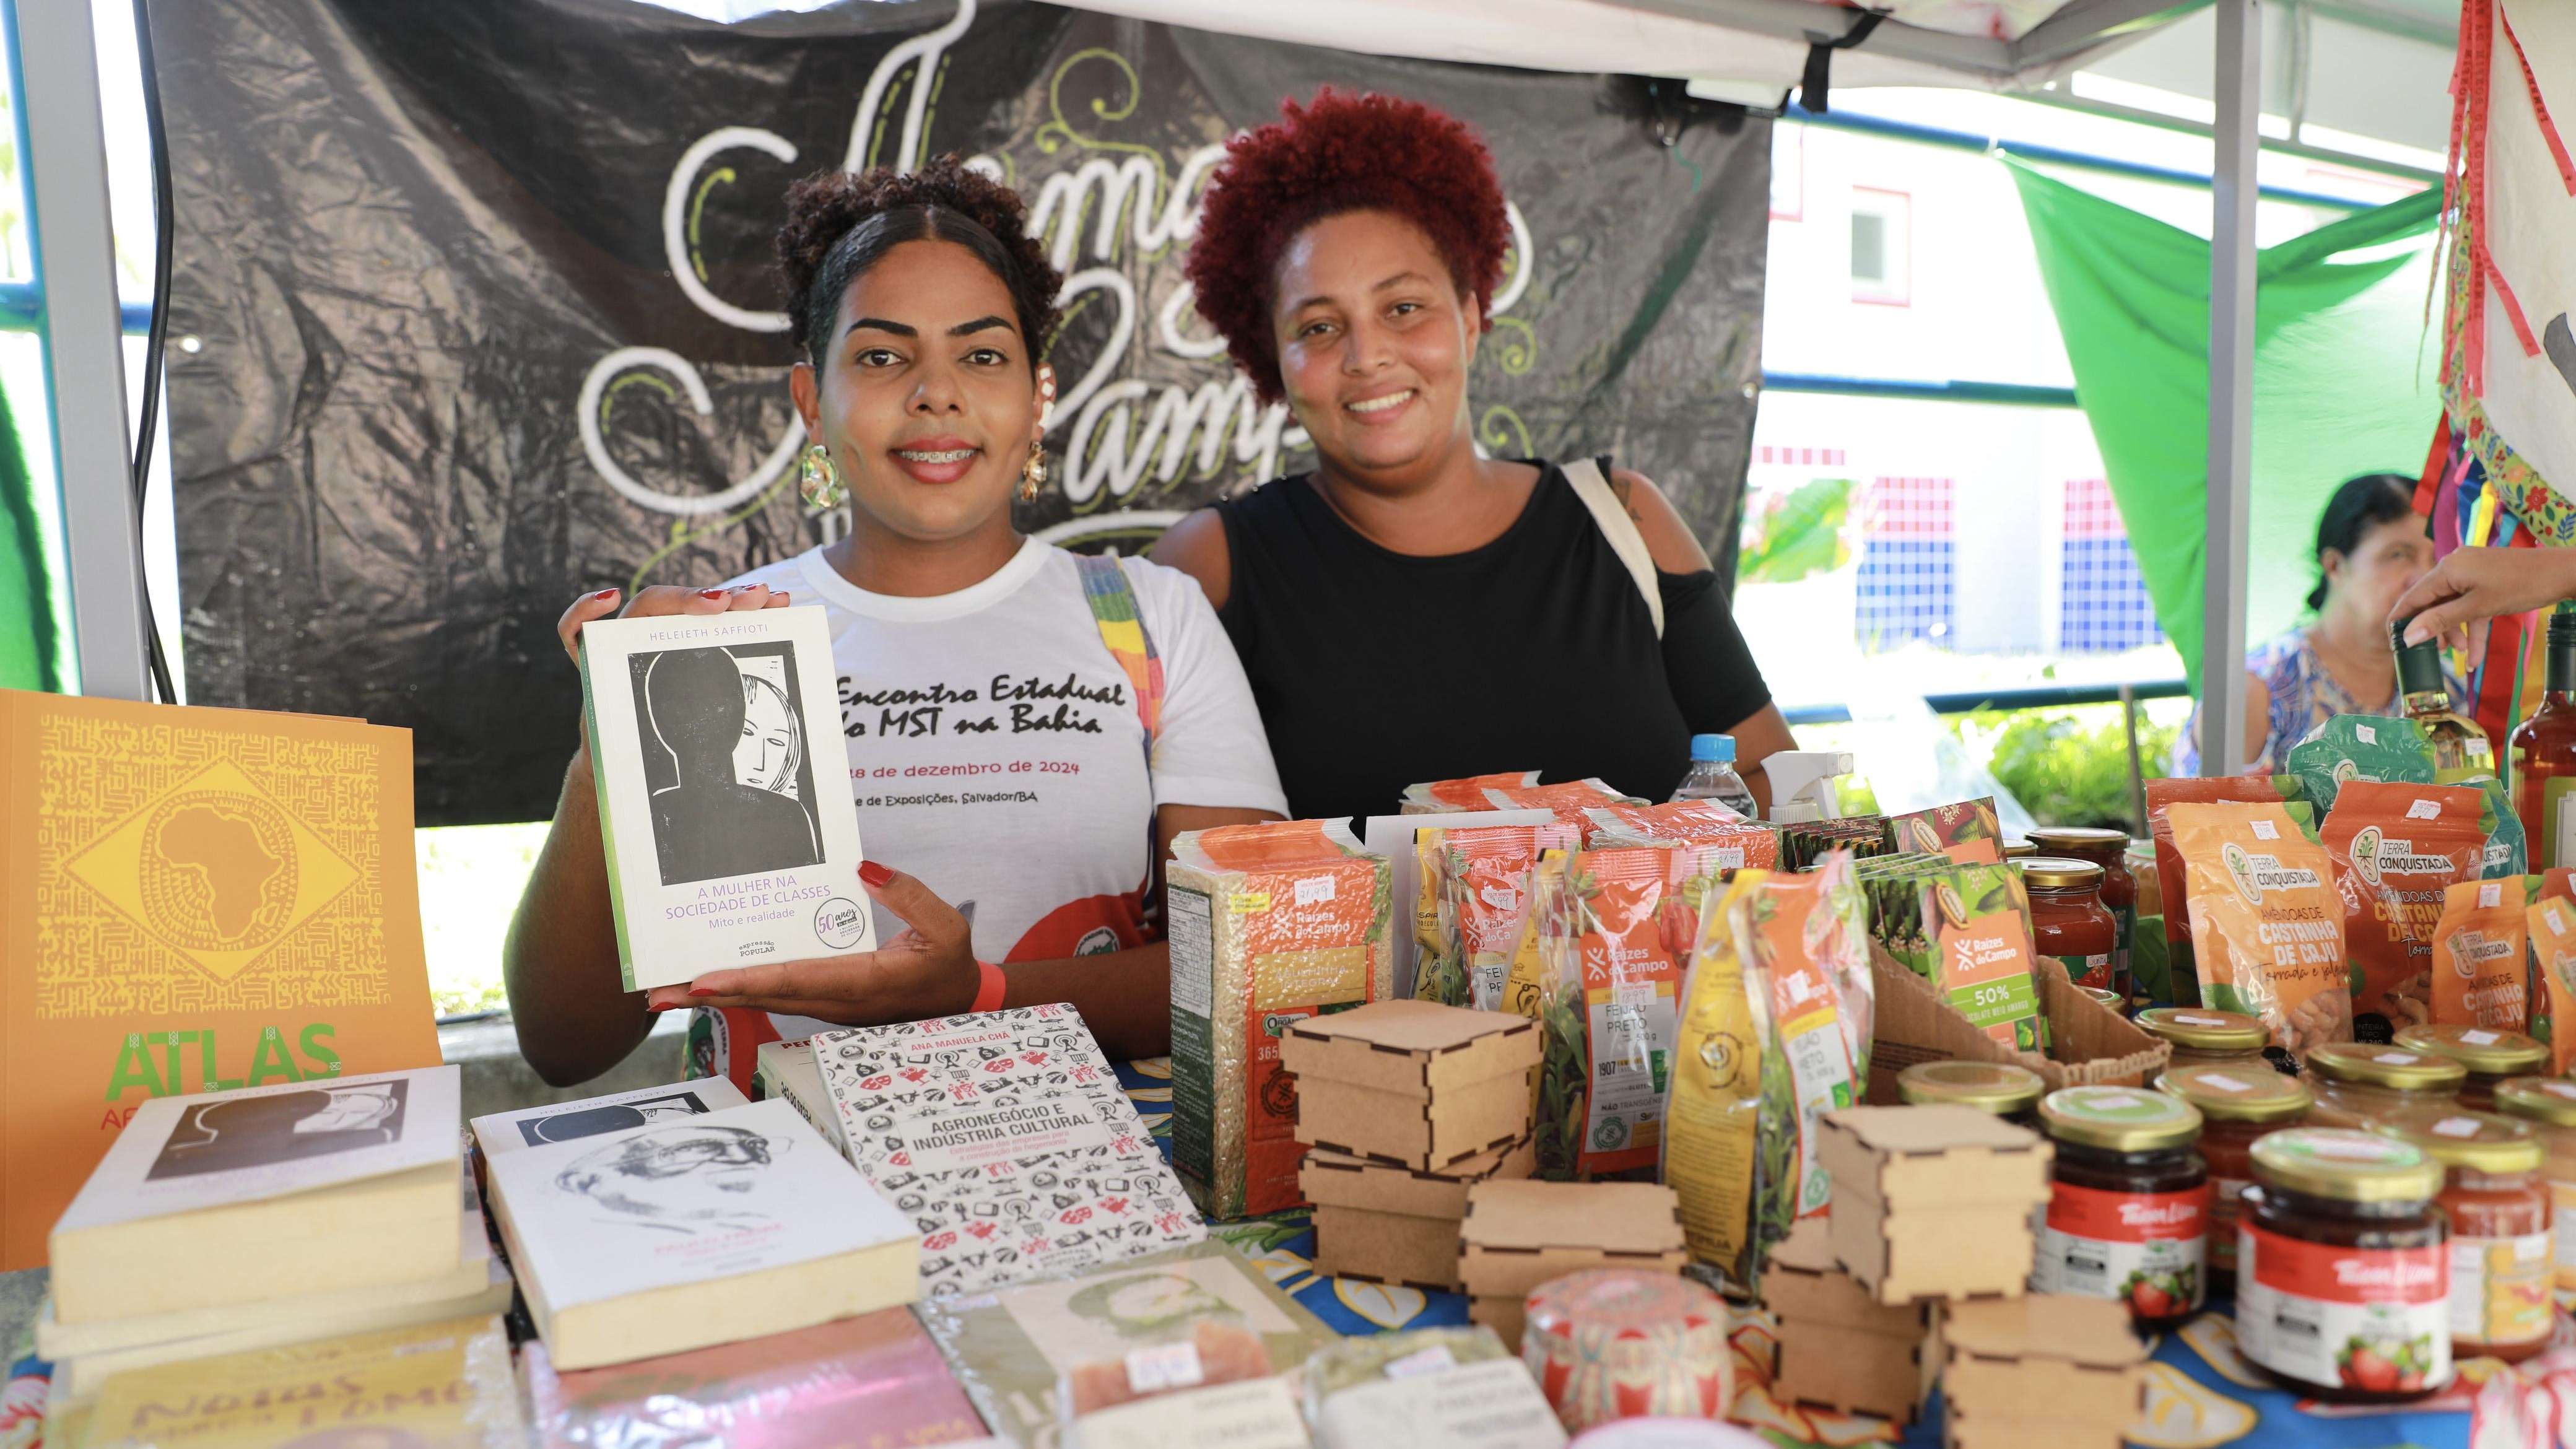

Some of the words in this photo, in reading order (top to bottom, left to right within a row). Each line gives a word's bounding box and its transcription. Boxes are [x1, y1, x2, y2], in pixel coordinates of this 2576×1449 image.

[650, 629, 708, 641] HELEIETH
[714, 624, 768, 636] SAFFIOTI
[837, 676, 978, 707] Encontro
[991, 673, 1125, 706] Estadual
[879, 707, 943, 738] MST
[954, 715, 999, 733] na
[1012, 703, 1103, 733] Bahia
[873, 767, 896, 778] de
[904, 761, 1001, 777] dezembro
[1009, 760, 1032, 772] de
[1040, 761, 1080, 776] 2024
[867, 795, 882, 806] de
[886, 793, 957, 807] Exposições,
[962, 791, 1038, 805] Salvador/BA
[2383, 842, 2409, 855] TERRA
[2251, 857, 2279, 870] TERRA
[2380, 857, 2452, 871] CONQUISTADA
[698, 888, 708, 899] A
[713, 879, 772, 897] MULHER
[777, 875, 797, 888] NA
[2257, 872, 2318, 887] CONQUISTADA
[666, 897, 747, 920] SOCIEDADE
[752, 894, 770, 907] DE
[774, 885, 830, 903] CLASSES
[2434, 890, 2445, 902] D
[709, 918, 734, 929] Mito
[747, 908, 795, 923] realidade
[2309, 907, 2324, 919] DE
[2374, 902, 2445, 922] CASTAN
[819, 913, 834, 934] 50
[2259, 920, 2338, 944] CASTANHA
[2387, 923, 2408, 942] DE
[739, 940, 775, 950] expressão
[740, 946, 776, 957] POPULAR
[1973, 938, 2004, 952] Raízes
[1985, 948, 2017, 962] Campo
[2273, 944, 2298, 966] DE
[2299, 942, 2338, 964] CAJU
[1486, 967, 1503, 978] FEI
[1621, 960, 1668, 975] Campo
[2312, 968, 2318, 977] e
[1975, 985, 2009, 1006] 50%
[1607, 1018, 1647, 1033] PRETO
[2356, 1023, 2384, 1031] INTEIRA
[911, 1043, 934, 1051] ANA
[936, 1035, 986, 1050] MANUELA
[1258, 1046, 1278, 1061] 365
[105, 1022, 341, 1102] ATLAS
[1598, 1061, 1616, 1076] 1907
[1601, 1102, 1619, 1111] NÃO
[932, 1105, 1049, 1134] AGRONEGÓCIO
[1053, 1103, 1066, 1115] E
[913, 1127, 1006, 1151] INDÚSTRIA
[1009, 1113, 1094, 1136] CULTURAL
